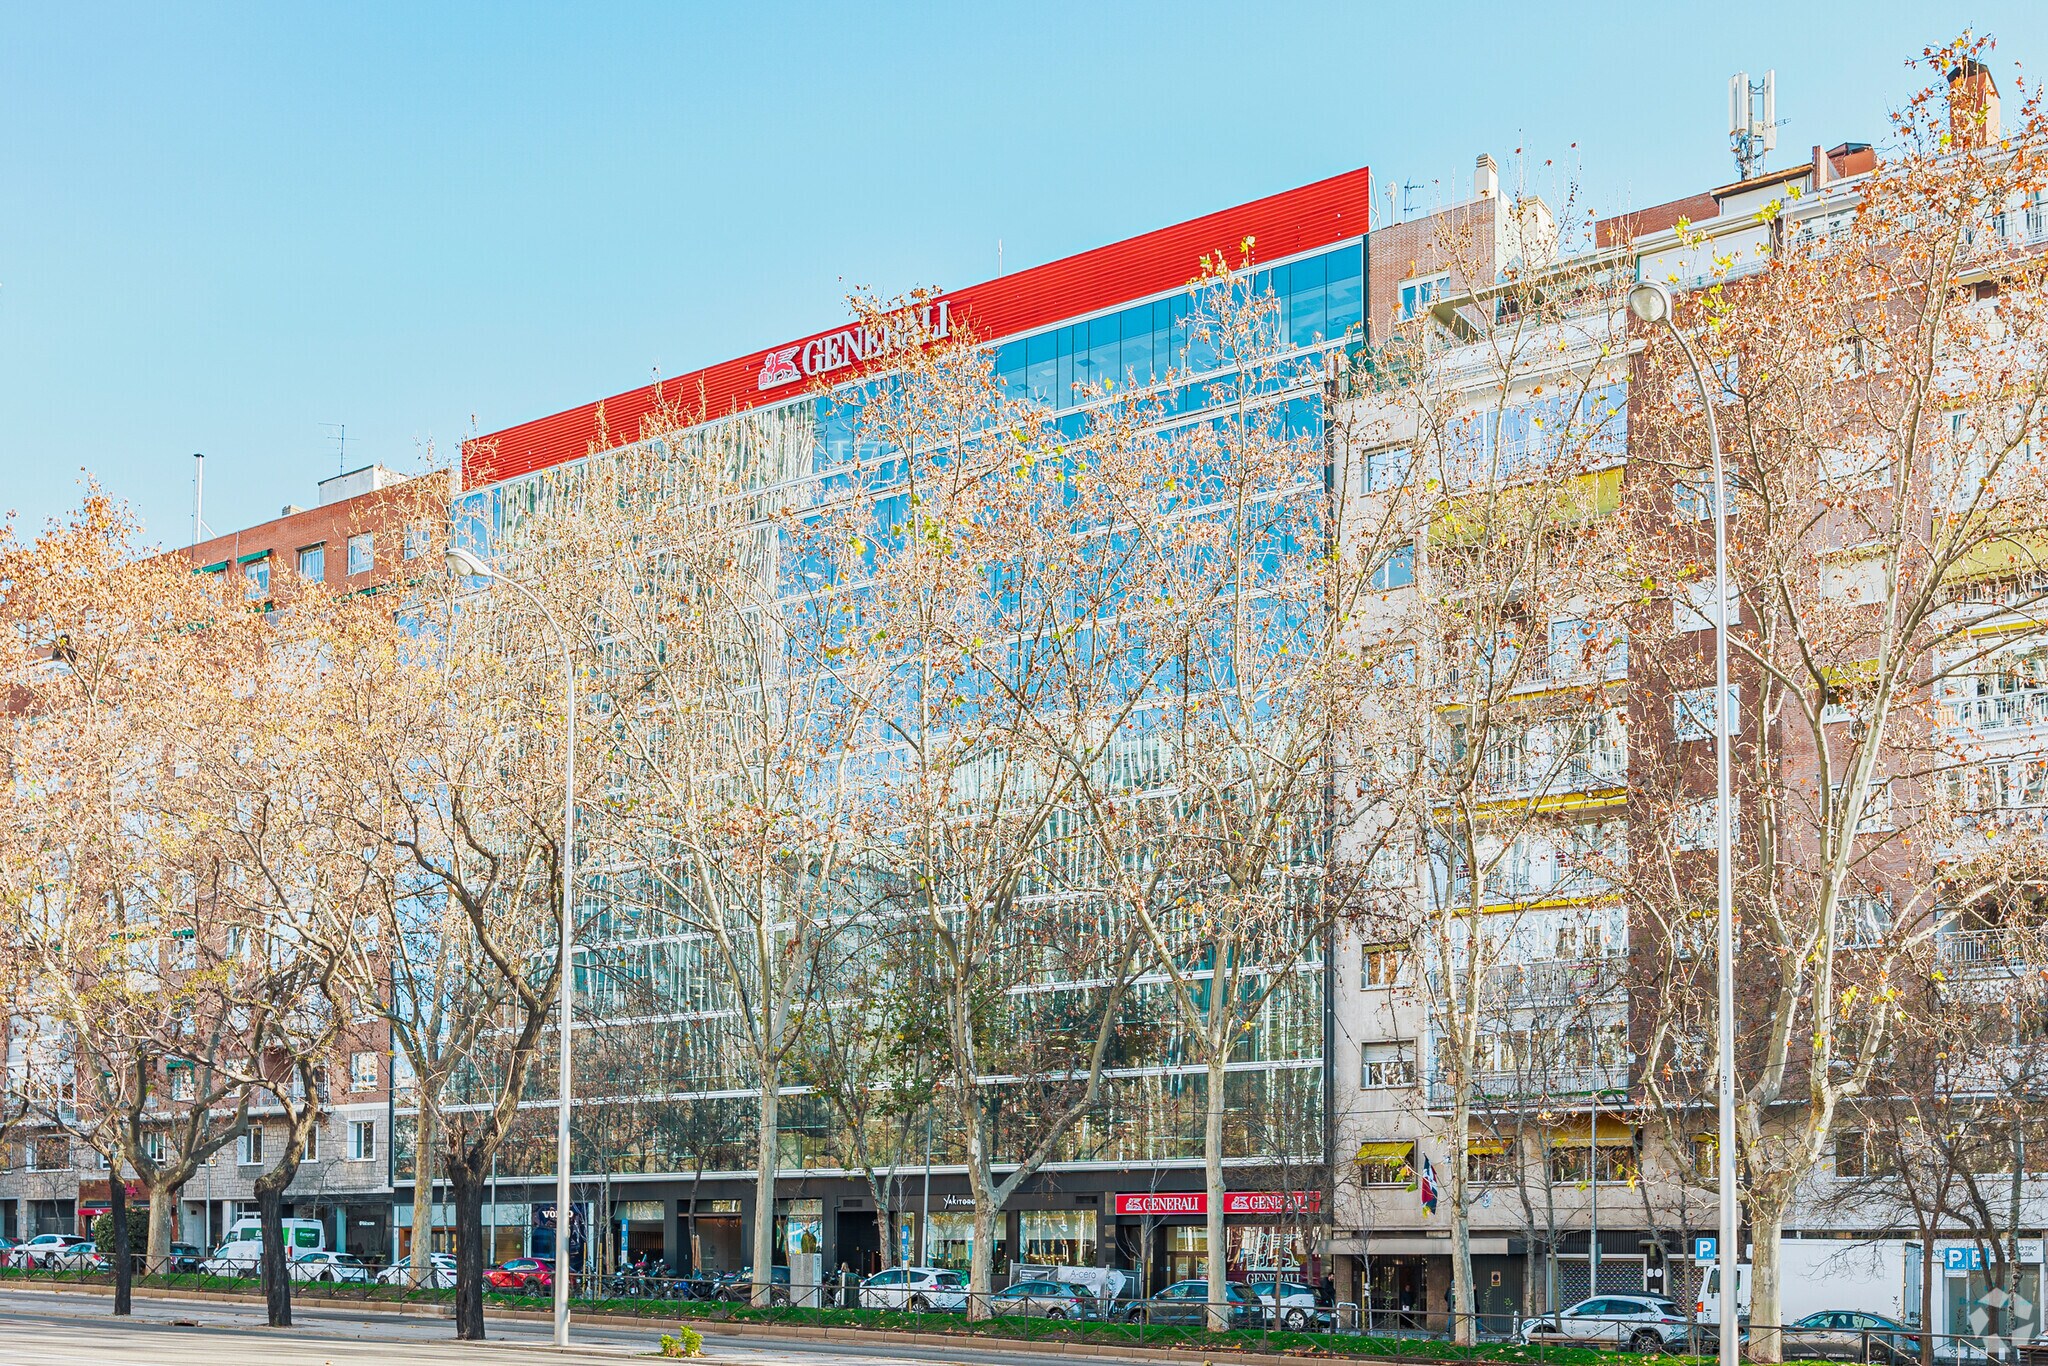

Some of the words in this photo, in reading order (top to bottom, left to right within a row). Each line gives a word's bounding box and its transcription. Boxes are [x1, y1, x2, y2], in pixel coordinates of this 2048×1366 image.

[801, 300, 951, 376] GENERALI
[1143, 1197, 1198, 1210] GENERALI
[542, 1210, 574, 1218] VOO
[1699, 1241, 1712, 1257] P
[1948, 1250, 1963, 1267] P
[1070, 1270, 1096, 1279] A-cero
